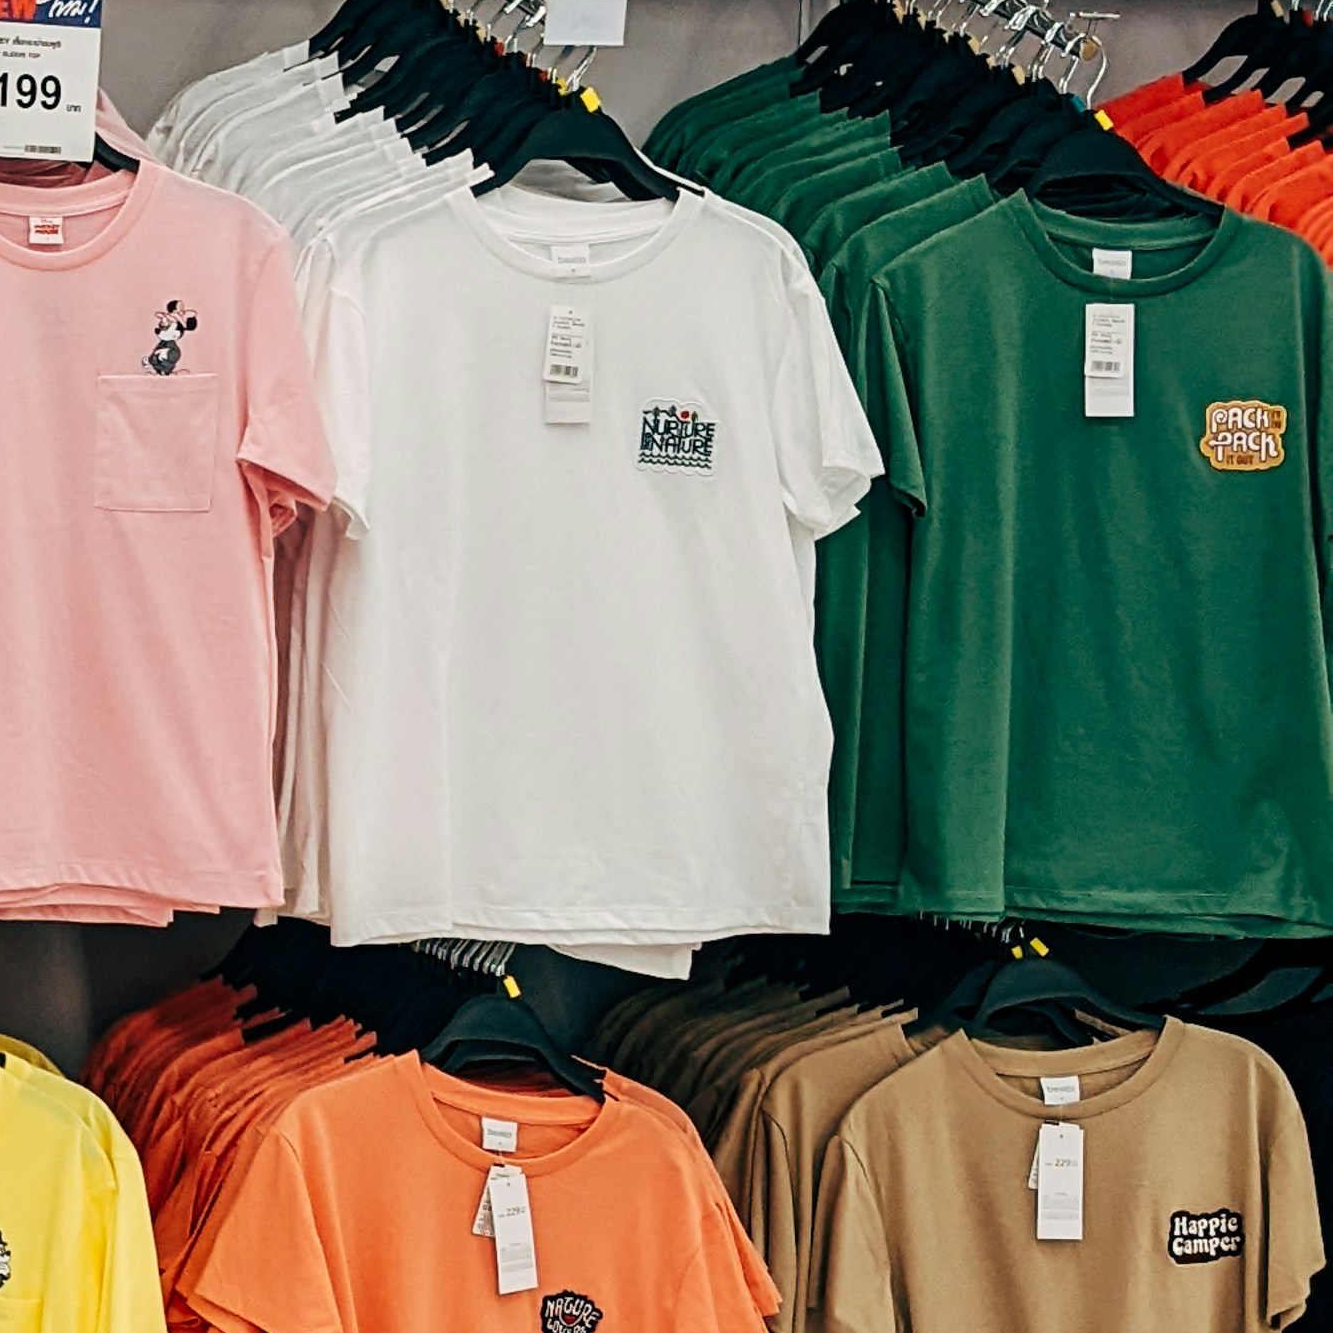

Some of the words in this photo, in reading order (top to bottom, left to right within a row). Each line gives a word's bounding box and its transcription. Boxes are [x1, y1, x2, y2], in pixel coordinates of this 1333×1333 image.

[643, 416, 715, 439] NURTURE
[1211, 408, 1269, 433] PACK
[651, 435, 713, 456] NATURE
[1208, 431, 1278, 462] PACK
[1173, 1236, 1241, 1256] Camper
[545, 1297, 600, 1328] NATURE
